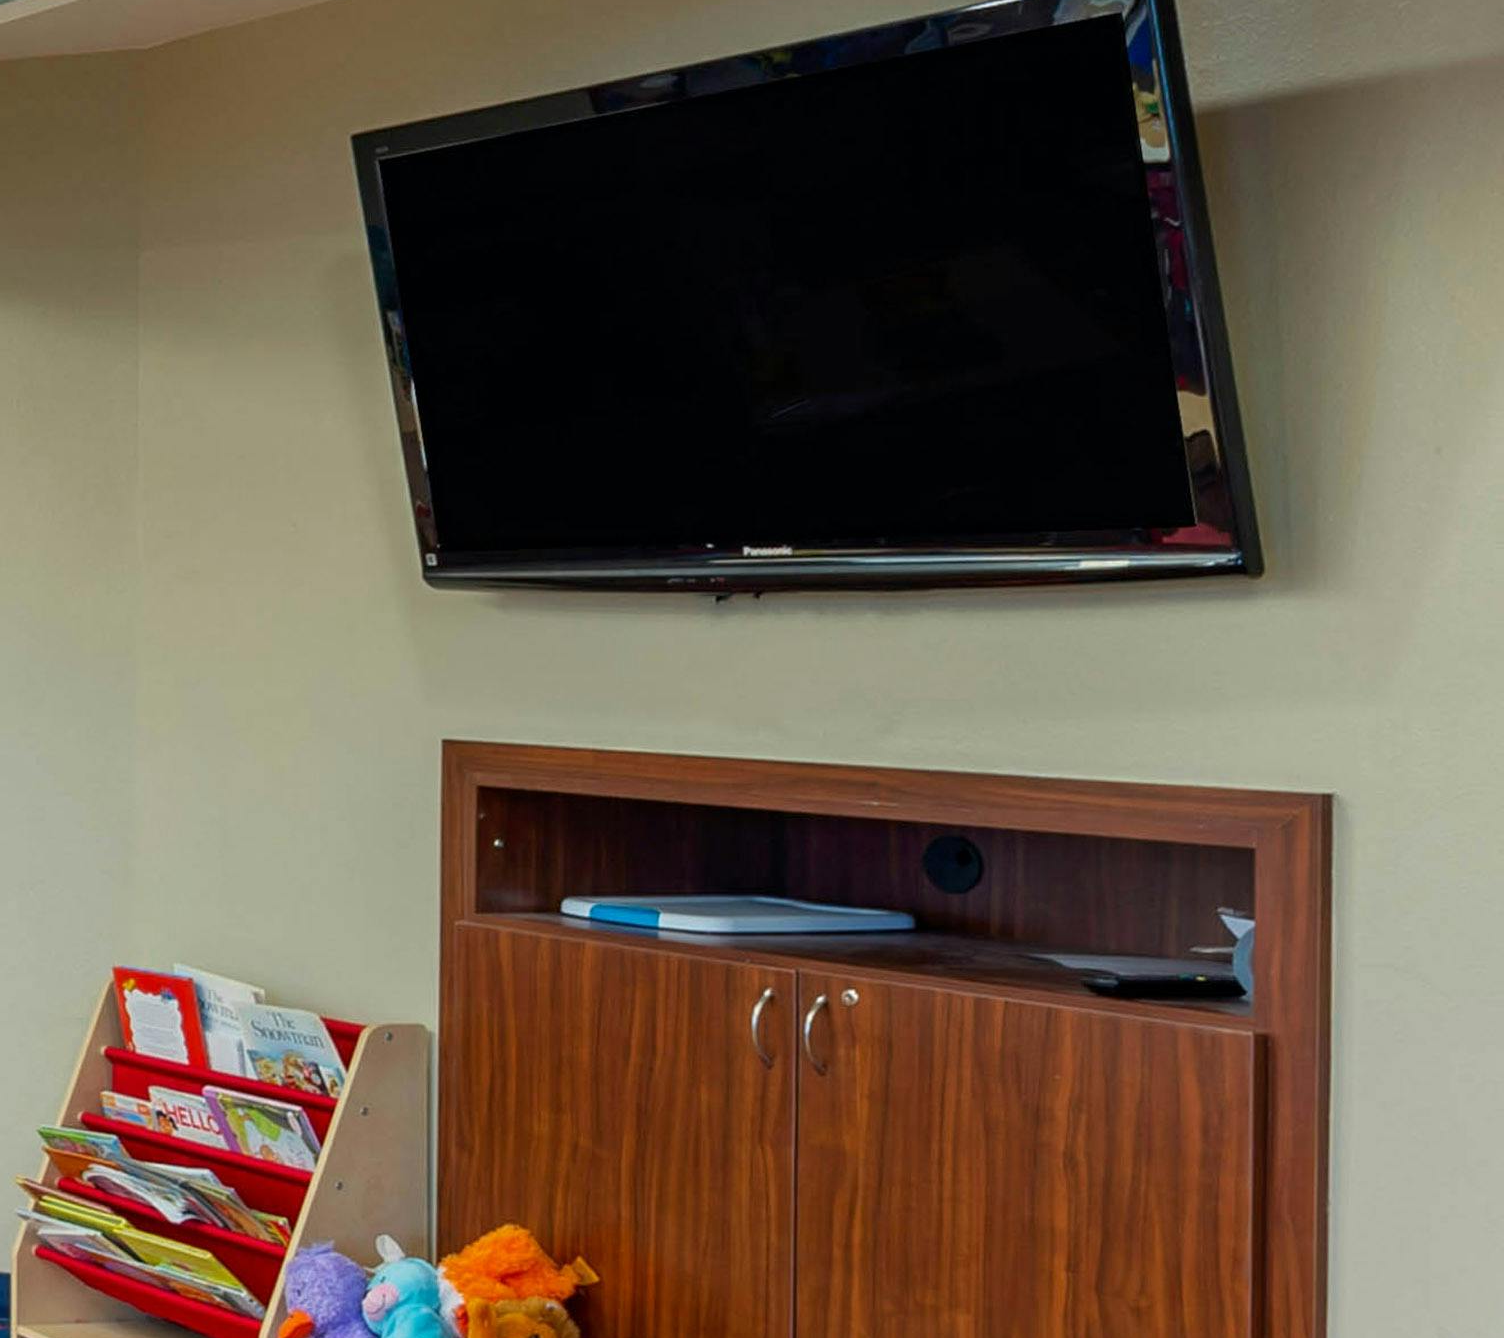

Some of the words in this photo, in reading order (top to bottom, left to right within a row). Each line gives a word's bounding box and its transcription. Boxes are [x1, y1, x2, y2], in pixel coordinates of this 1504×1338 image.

[742, 546, 793, 556] Panasonic
[266, 1010, 295, 1029] The
[250, 1020, 324, 1049] Snowman
[165, 1102, 222, 1135] HELLO
